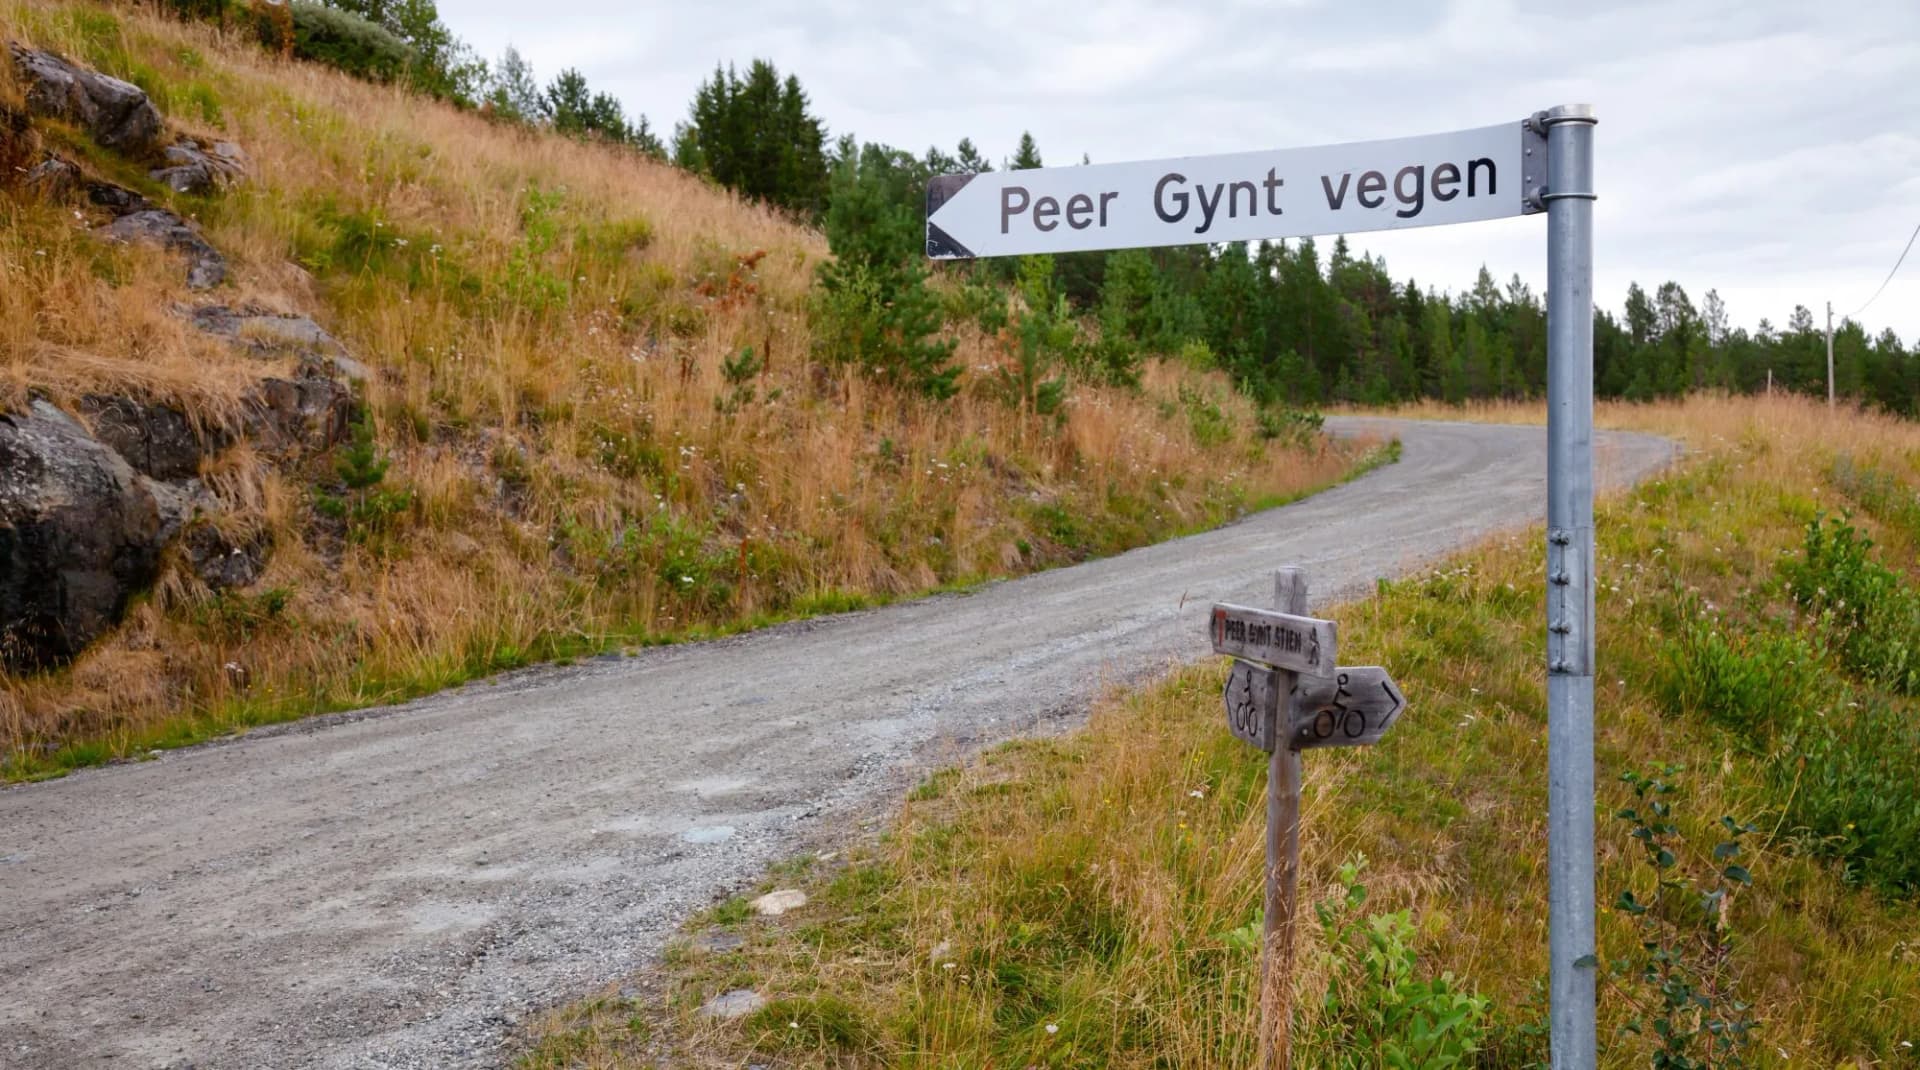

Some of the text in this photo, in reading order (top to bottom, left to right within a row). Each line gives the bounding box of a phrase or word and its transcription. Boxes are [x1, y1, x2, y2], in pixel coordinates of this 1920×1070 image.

[1000, 156, 1497, 234] Peer Gynt vegen
[1225, 619, 1246, 643] PEER
[1274, 626, 1302, 653] STIEN
